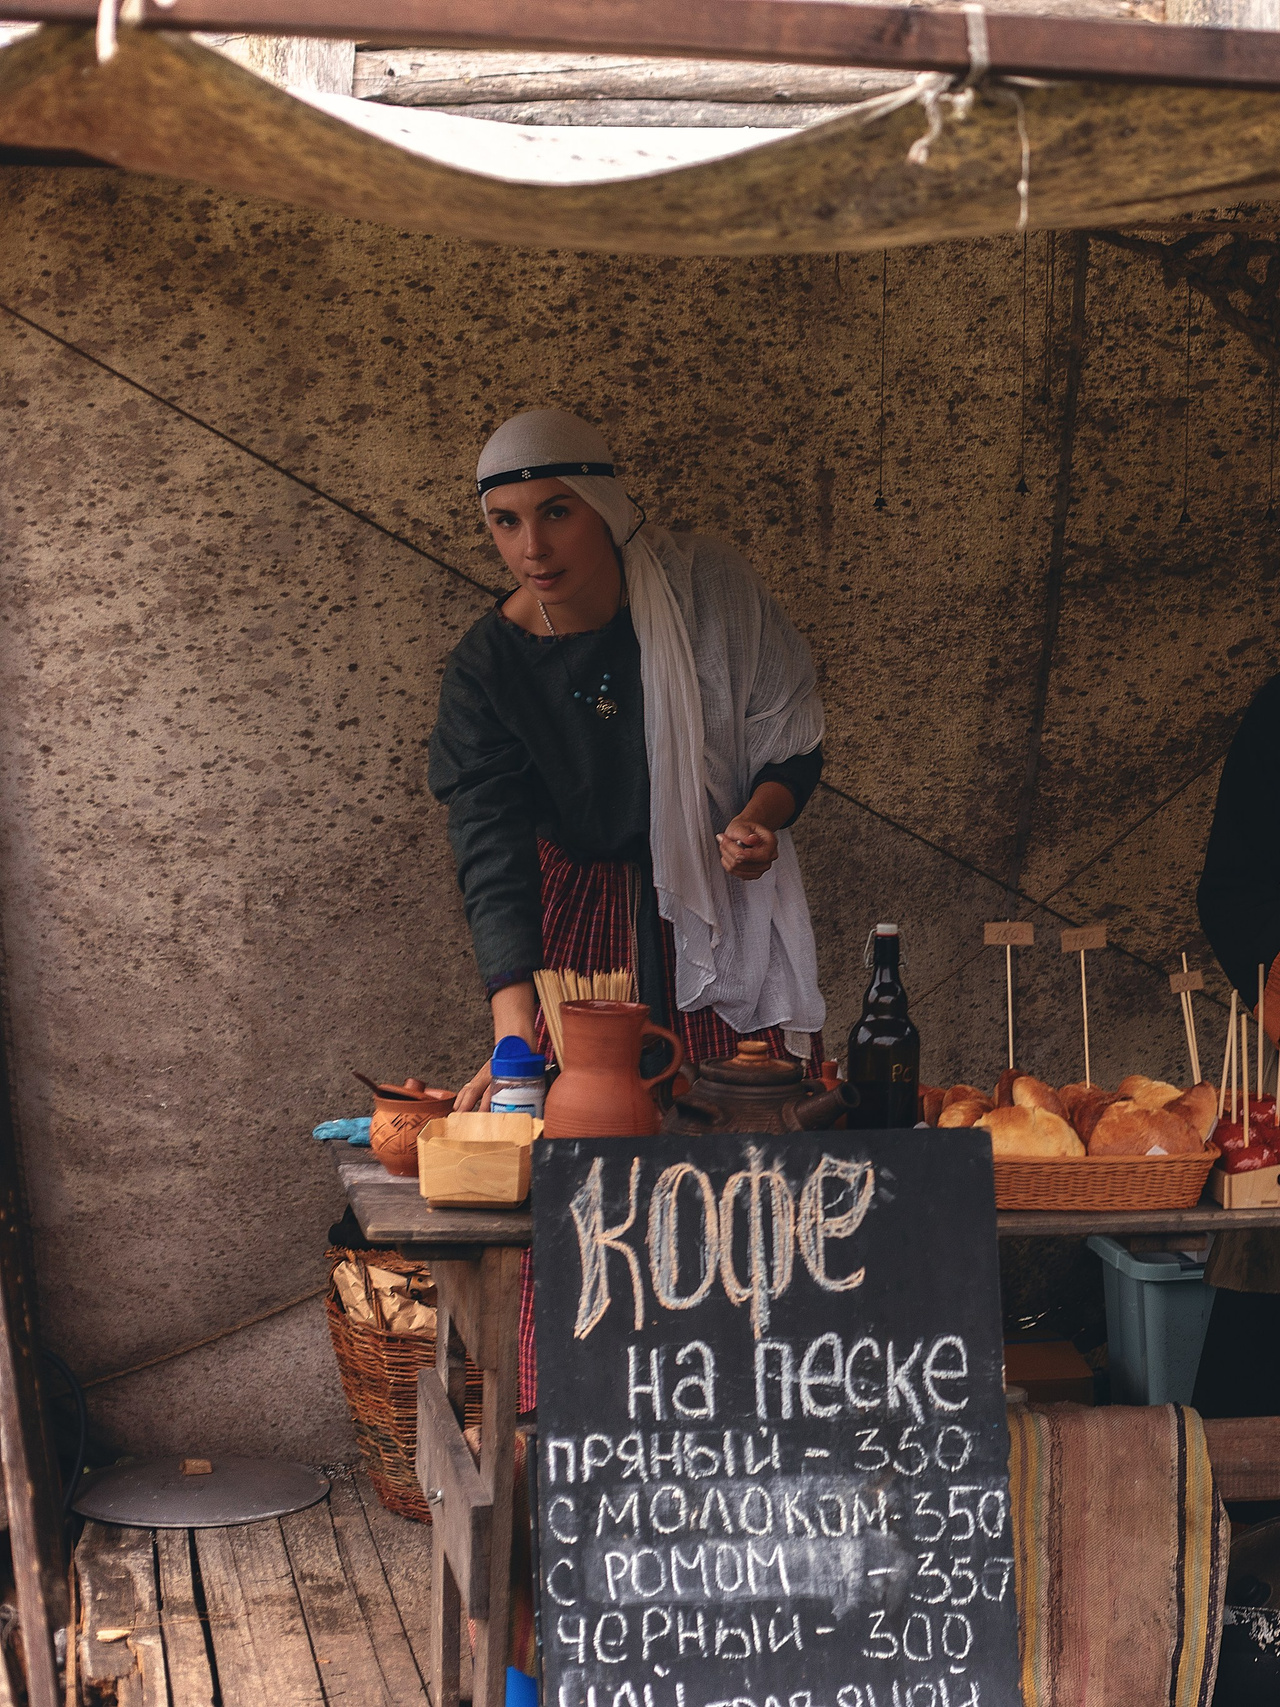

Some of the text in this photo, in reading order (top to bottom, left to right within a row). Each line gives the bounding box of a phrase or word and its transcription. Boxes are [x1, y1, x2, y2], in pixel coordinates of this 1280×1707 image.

[627, 1332, 970, 1426] на песке
[854, 1425, 974, 1477] 350
[912, 1485, 1006, 1544] 350
[861, 1610, 975, 1663] 300
